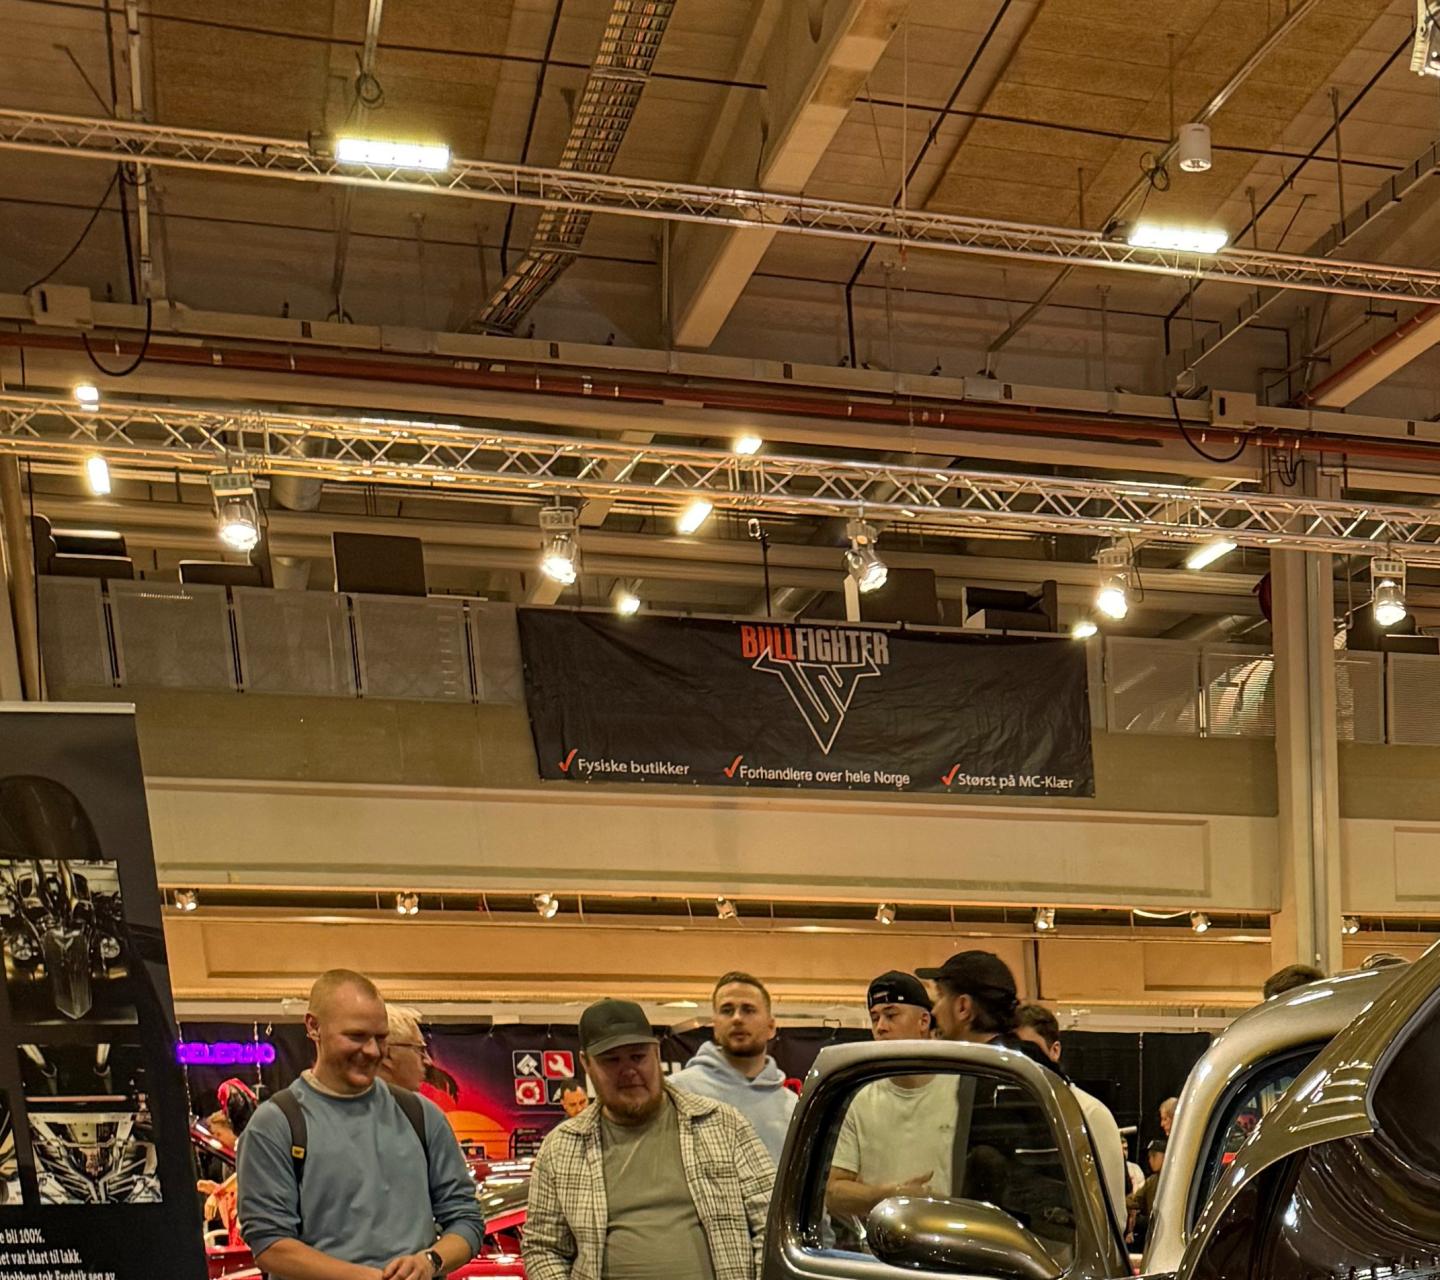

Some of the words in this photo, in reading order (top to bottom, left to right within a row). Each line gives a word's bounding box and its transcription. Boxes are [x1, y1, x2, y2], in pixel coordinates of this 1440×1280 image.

[741, 625, 890, 665] BULLFIGHTER
[578, 758, 628, 774] Fysiske
[630, 760, 690, 776] butikker
[739, 765, 813, 782] Forhandlere
[815, 771, 842, 782] over
[845, 769, 871, 783] hele
[874, 770, 910, 786] Norge
[958, 772, 997, 787] Størst
[1000, 773, 1017, 790] på
[1019, 775, 1074, 789] MC-Klær
[5, 1228, 18, 1244] bli
[20, 1228, 45, 1244] 100%.
[0, 1251, 10, 1266] et
[11, 1253, 26, 1265] var
[26, 1249, 48, 1265] klart
[49, 1249, 60, 1264] til
[60, 1248, 82, 1264] lakk.
